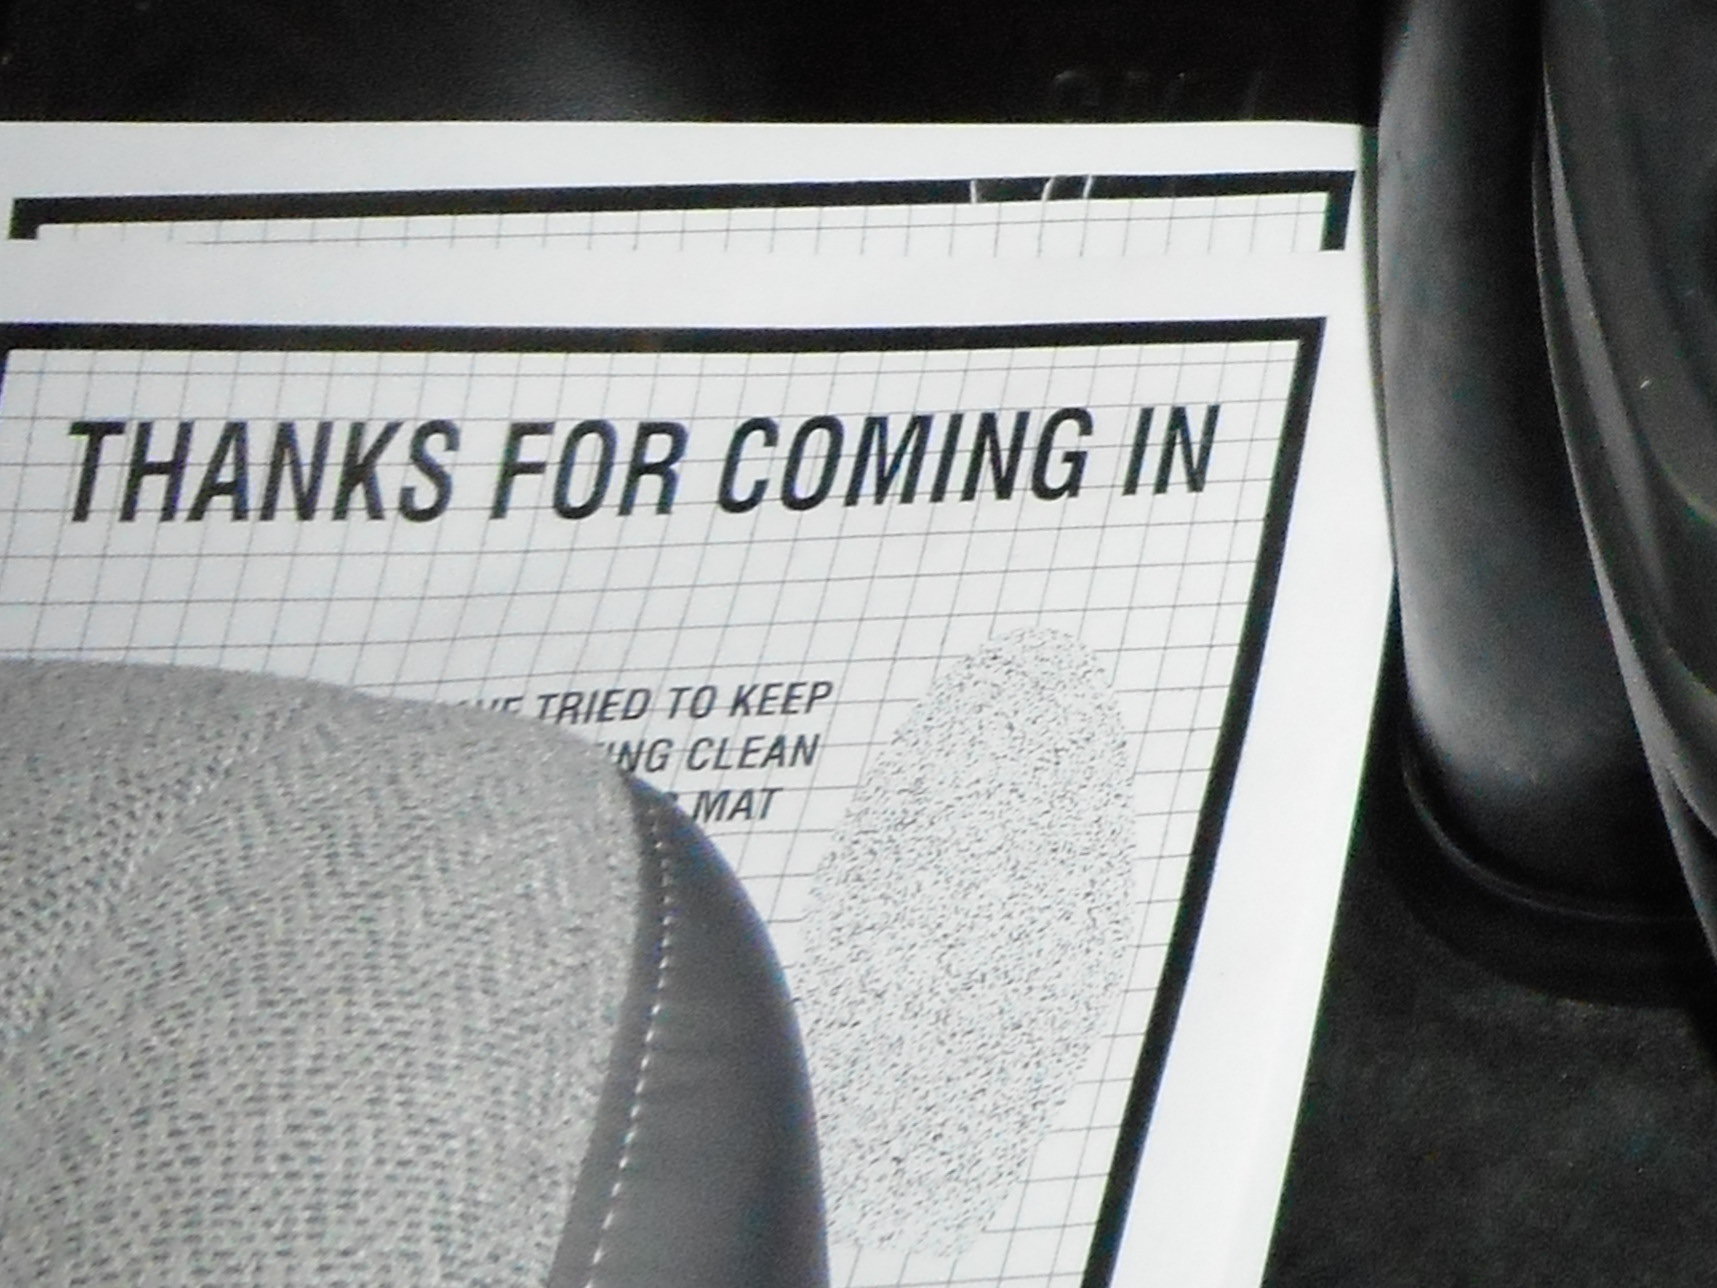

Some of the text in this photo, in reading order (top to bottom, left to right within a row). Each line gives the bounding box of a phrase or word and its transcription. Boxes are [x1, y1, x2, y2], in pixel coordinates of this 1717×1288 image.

[67, 404, 1223, 523] THANKS FOR COMING IN
[536, 688, 652, 725] TRIED
[667, 685, 717, 721] TO
[728, 680, 834, 719] KEEP
[686, 733, 821, 772] CLEAN
[690, 787, 783, 823] MAT
